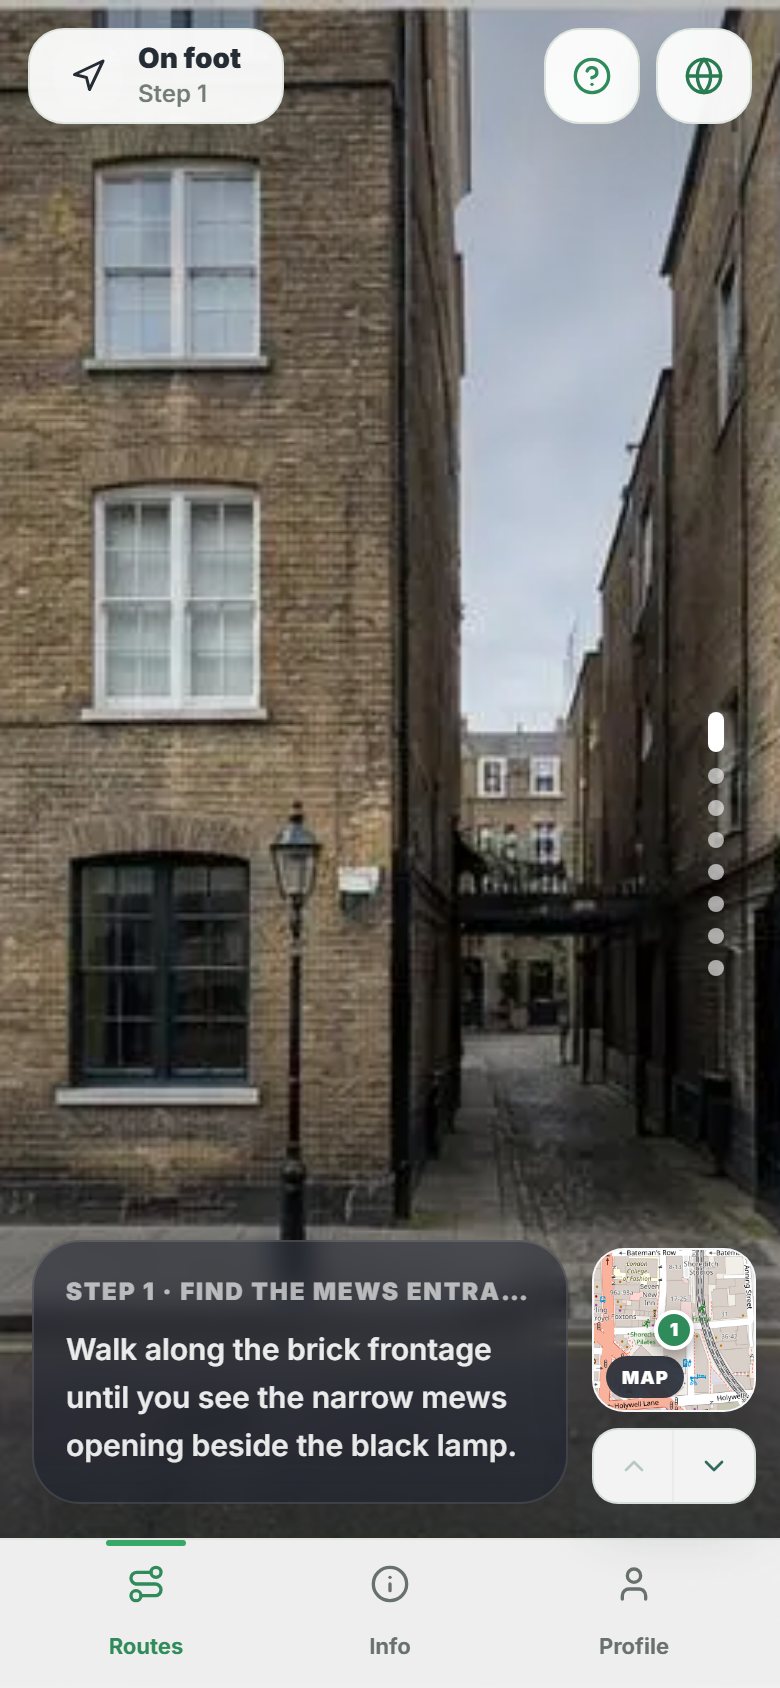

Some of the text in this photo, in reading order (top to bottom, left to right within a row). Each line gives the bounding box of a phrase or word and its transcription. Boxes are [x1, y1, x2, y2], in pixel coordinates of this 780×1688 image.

[138, 46, 242, 69] On foot
[138, 84, 206, 107] Step 1
[626, 1249, 661, 1257] Bateman's
[66, 1281, 135, 1301] STEP
[144, 1281, 154, 1301] 1
[181, 1281, 243, 1301] FIND
[252, 1281, 305, 1301] THE
[313, 1281, 399, 1301] MEWS
[670, 1322, 679, 1336] 1
[66, 1337, 492, 1368] Walk along the brick frontage
[622, 1371, 669, 1385] MAP
[67, 1385, 507, 1415] until you see the narrow mews
[66, 1433, 516, 1463] opening beside the black lamp.
[109, 1637, 184, 1655] Routes
[369, 1637, 411, 1655] Info
[599, 1637, 670, 1655] Profile
